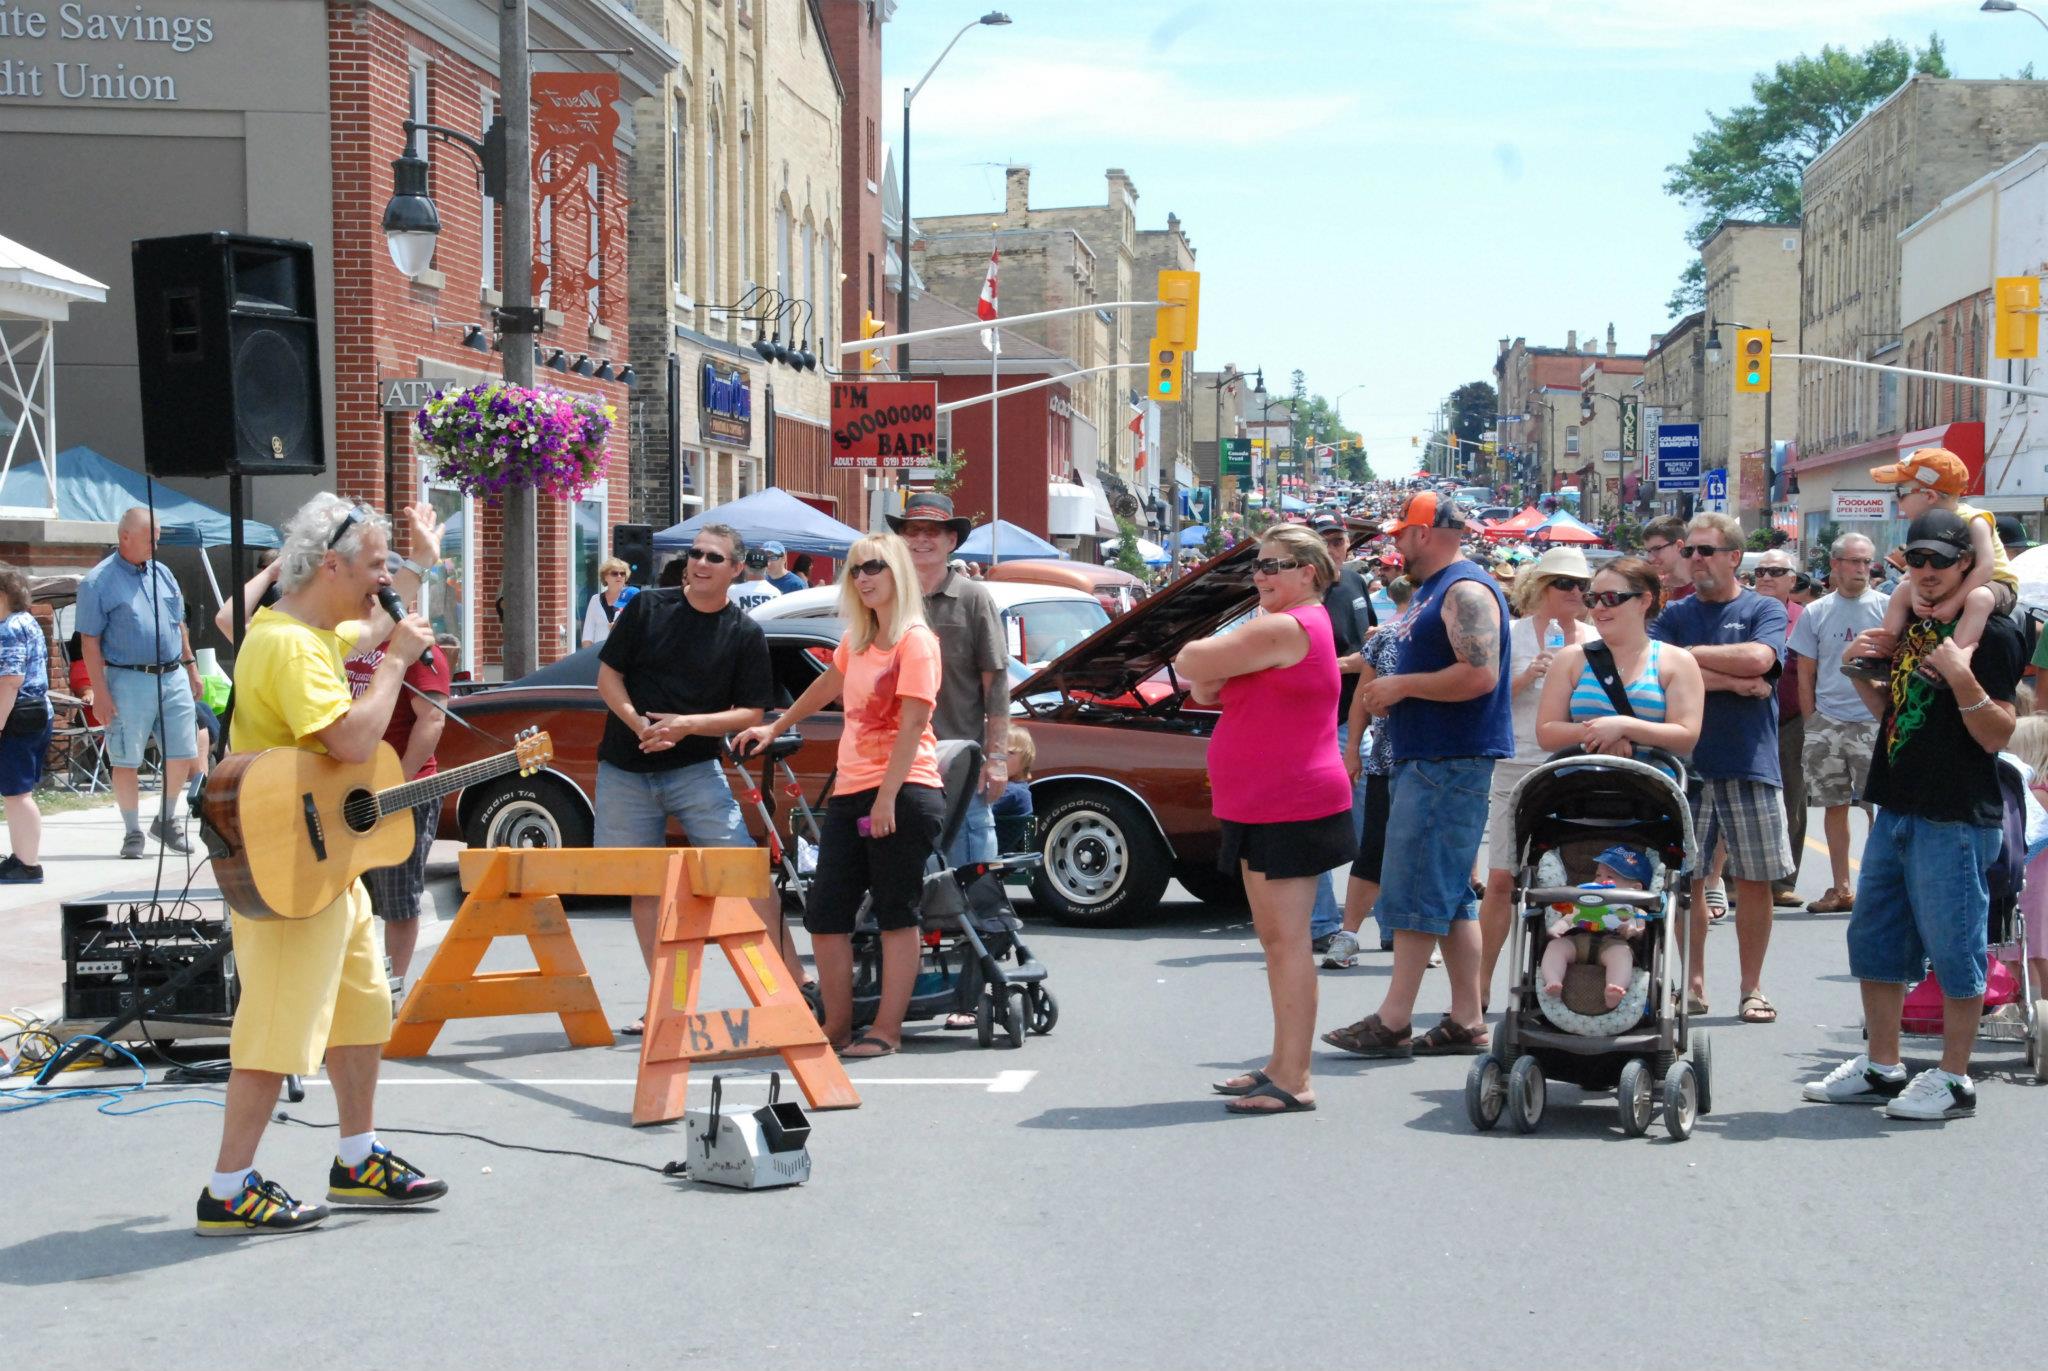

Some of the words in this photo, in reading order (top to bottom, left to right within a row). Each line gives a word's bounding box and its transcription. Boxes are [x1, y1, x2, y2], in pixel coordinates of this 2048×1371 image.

[60, 3, 213, 52] Savings
[54, 62, 178, 101] Union
[834, 386, 868, 408] I'M
[877, 432, 934, 456] BAD!
[1624, 404, 1635, 450] TAVERN
[834, 457, 854, 466] ADULT
[857, 457, 877, 466] STORE
[883, 457, 899, 466] (519)
[481, 791, 514, 824] Radial
[517, 790, 536, 799] T/A
